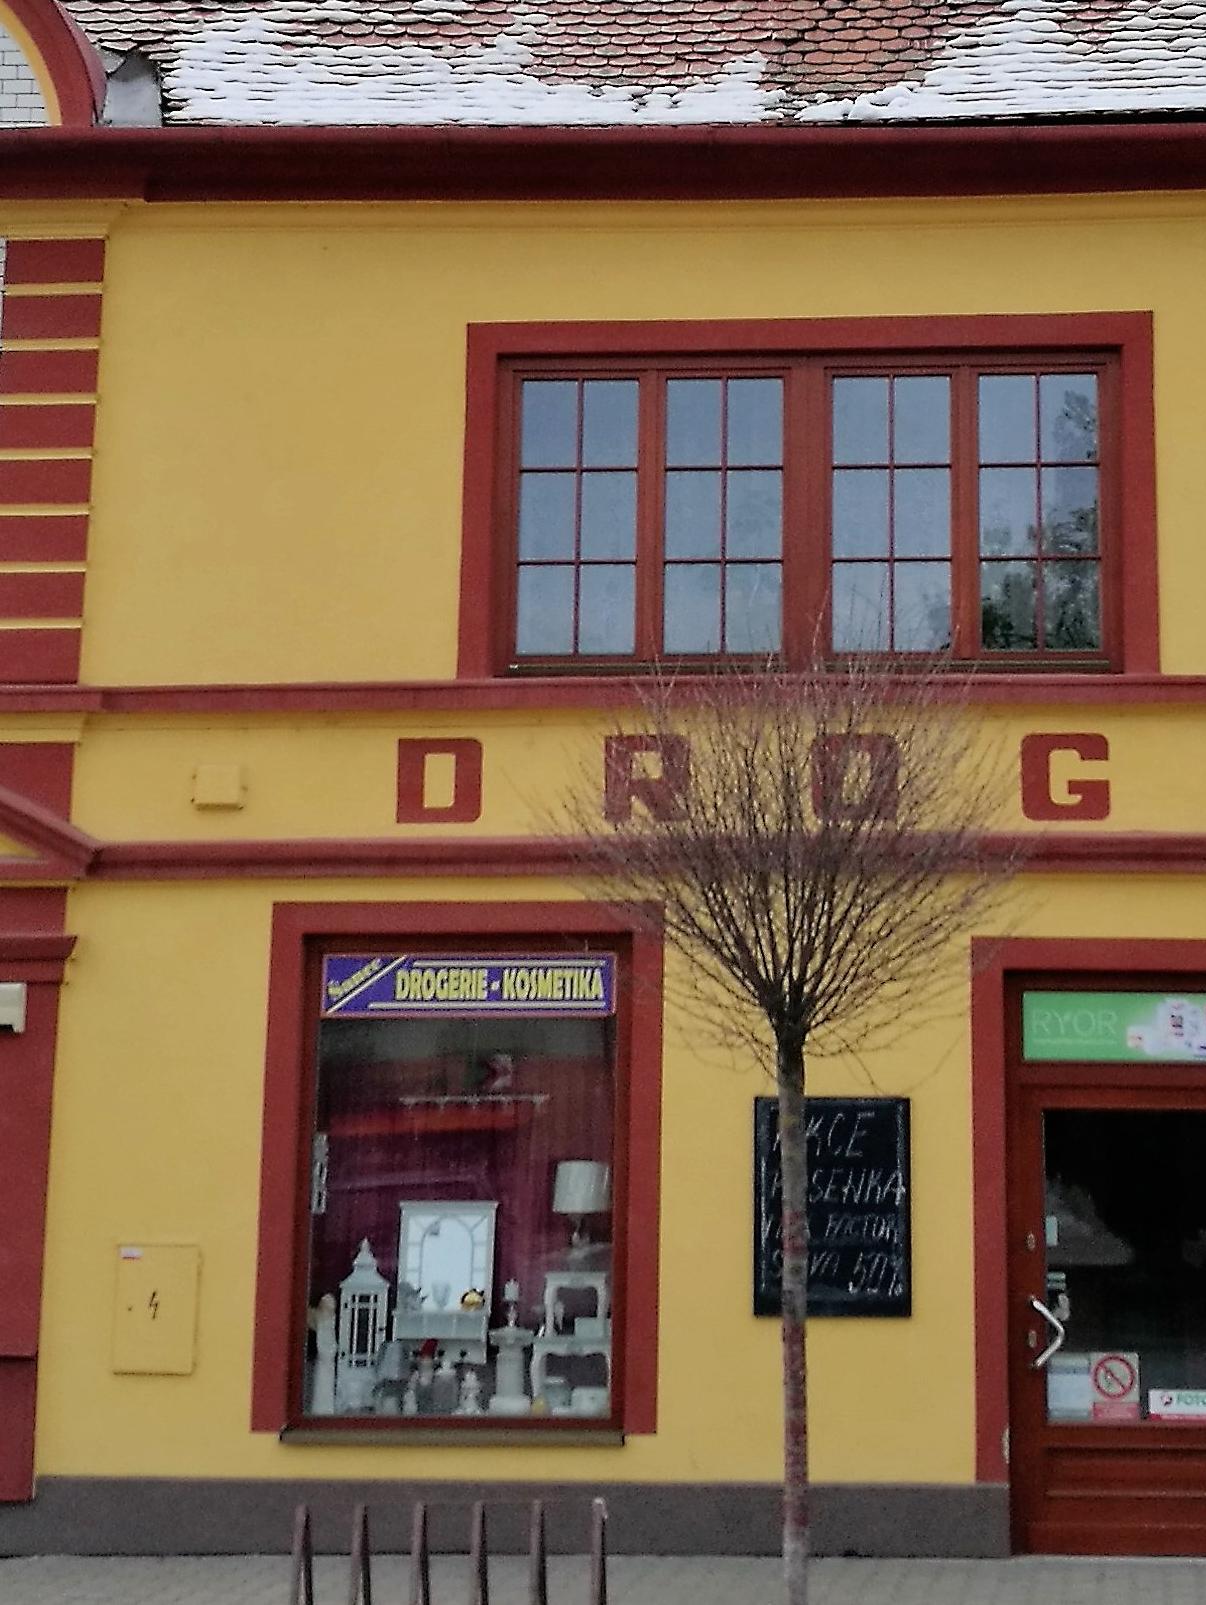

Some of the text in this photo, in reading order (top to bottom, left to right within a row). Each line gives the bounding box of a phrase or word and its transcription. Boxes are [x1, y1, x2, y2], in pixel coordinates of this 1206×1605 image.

[394, 968, 488, 1001] DROGERIE
[501, 968, 605, 1001] KOSMETIKA
[1031, 1009, 1119, 1037] RYOR
